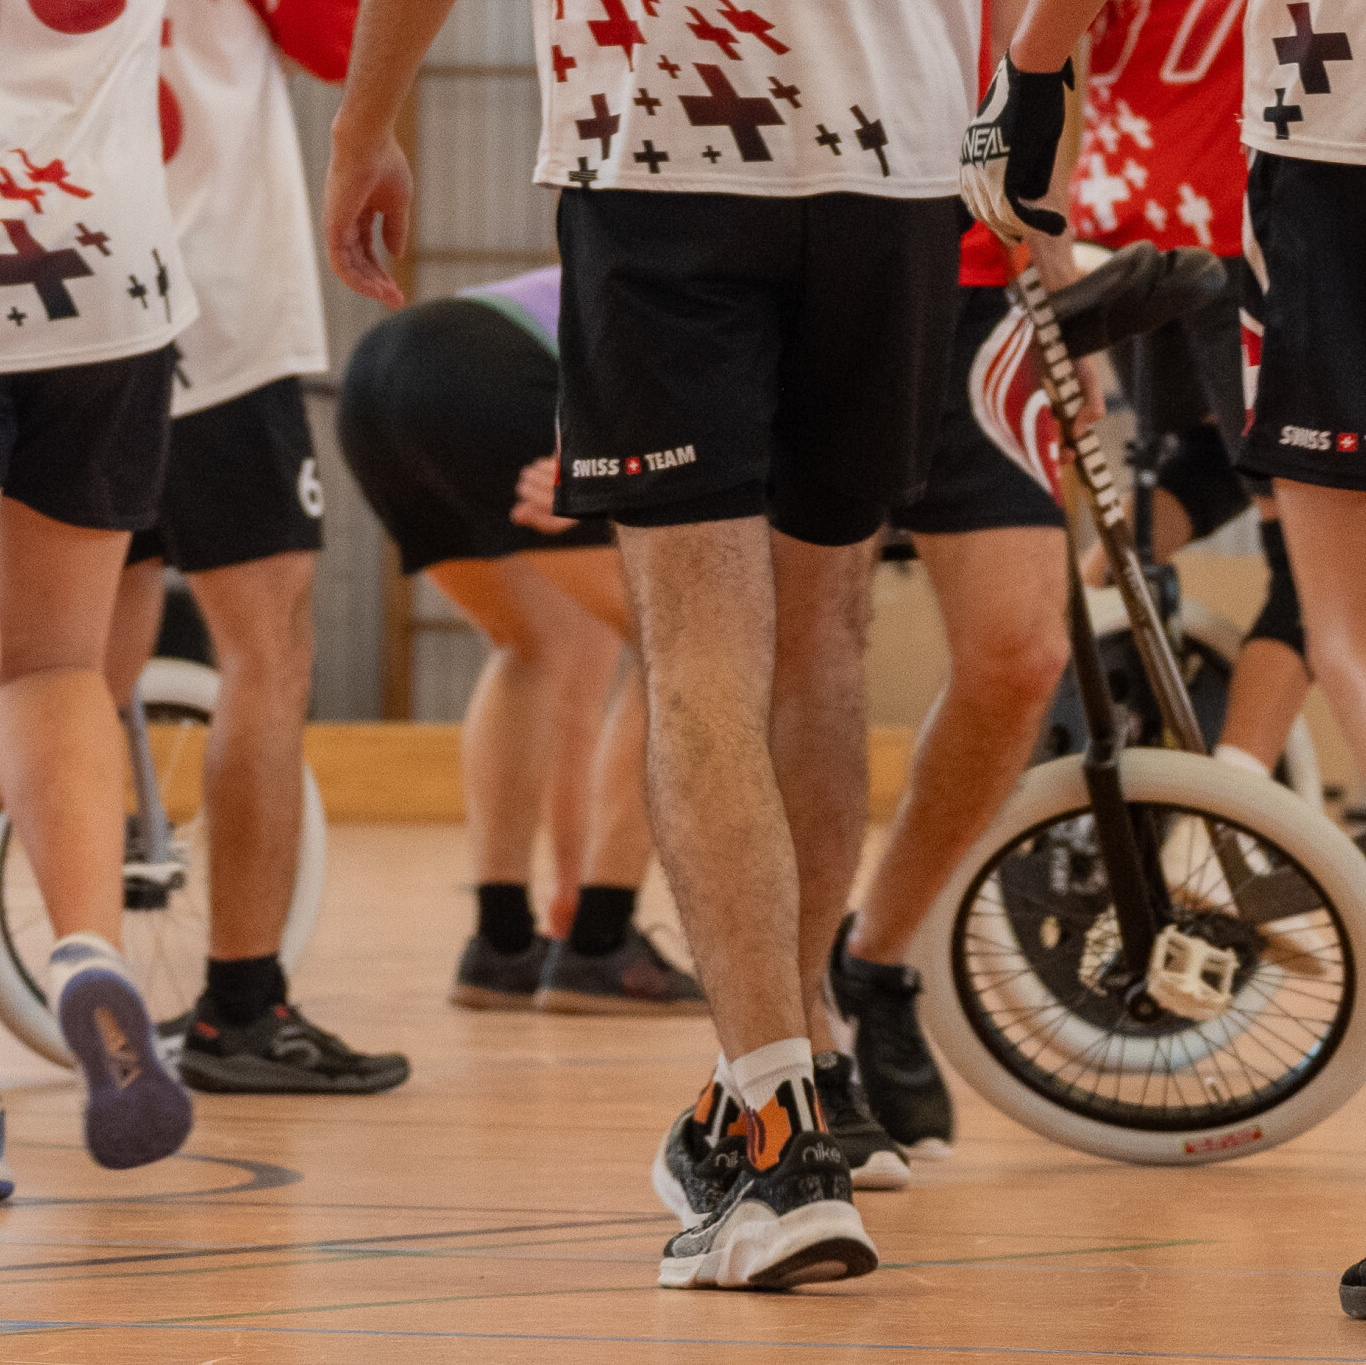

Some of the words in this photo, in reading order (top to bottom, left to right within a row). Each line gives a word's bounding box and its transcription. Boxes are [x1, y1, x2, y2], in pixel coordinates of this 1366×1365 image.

[1279, 425, 1332, 451] SWISS
[572, 458, 620, 478] SWISS
[644, 445, 696, 472] TEAM
